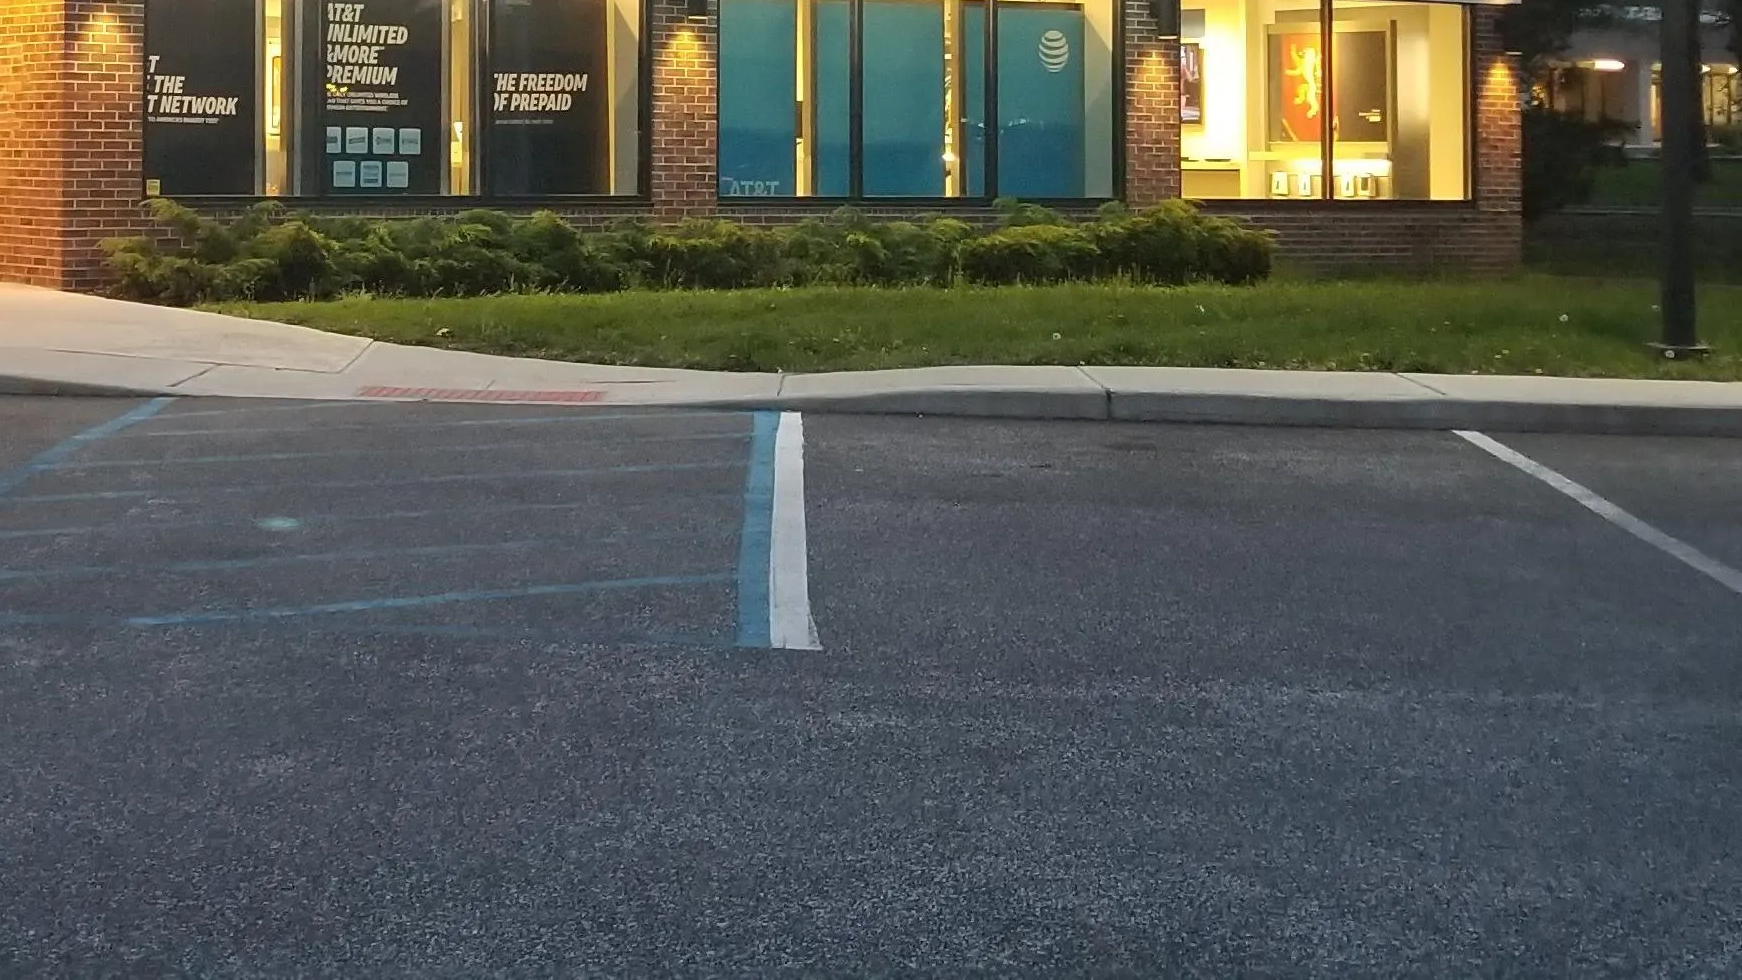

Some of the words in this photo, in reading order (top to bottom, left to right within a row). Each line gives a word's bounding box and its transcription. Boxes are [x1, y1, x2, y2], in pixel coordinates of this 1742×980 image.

[154, 75, 186, 94] THE
[493, 73, 518, 92] HE
[518, 73, 588, 92] FREEDOM
[159, 95, 239, 116] NETWORK
[510, 93, 572, 112] PREPAID
